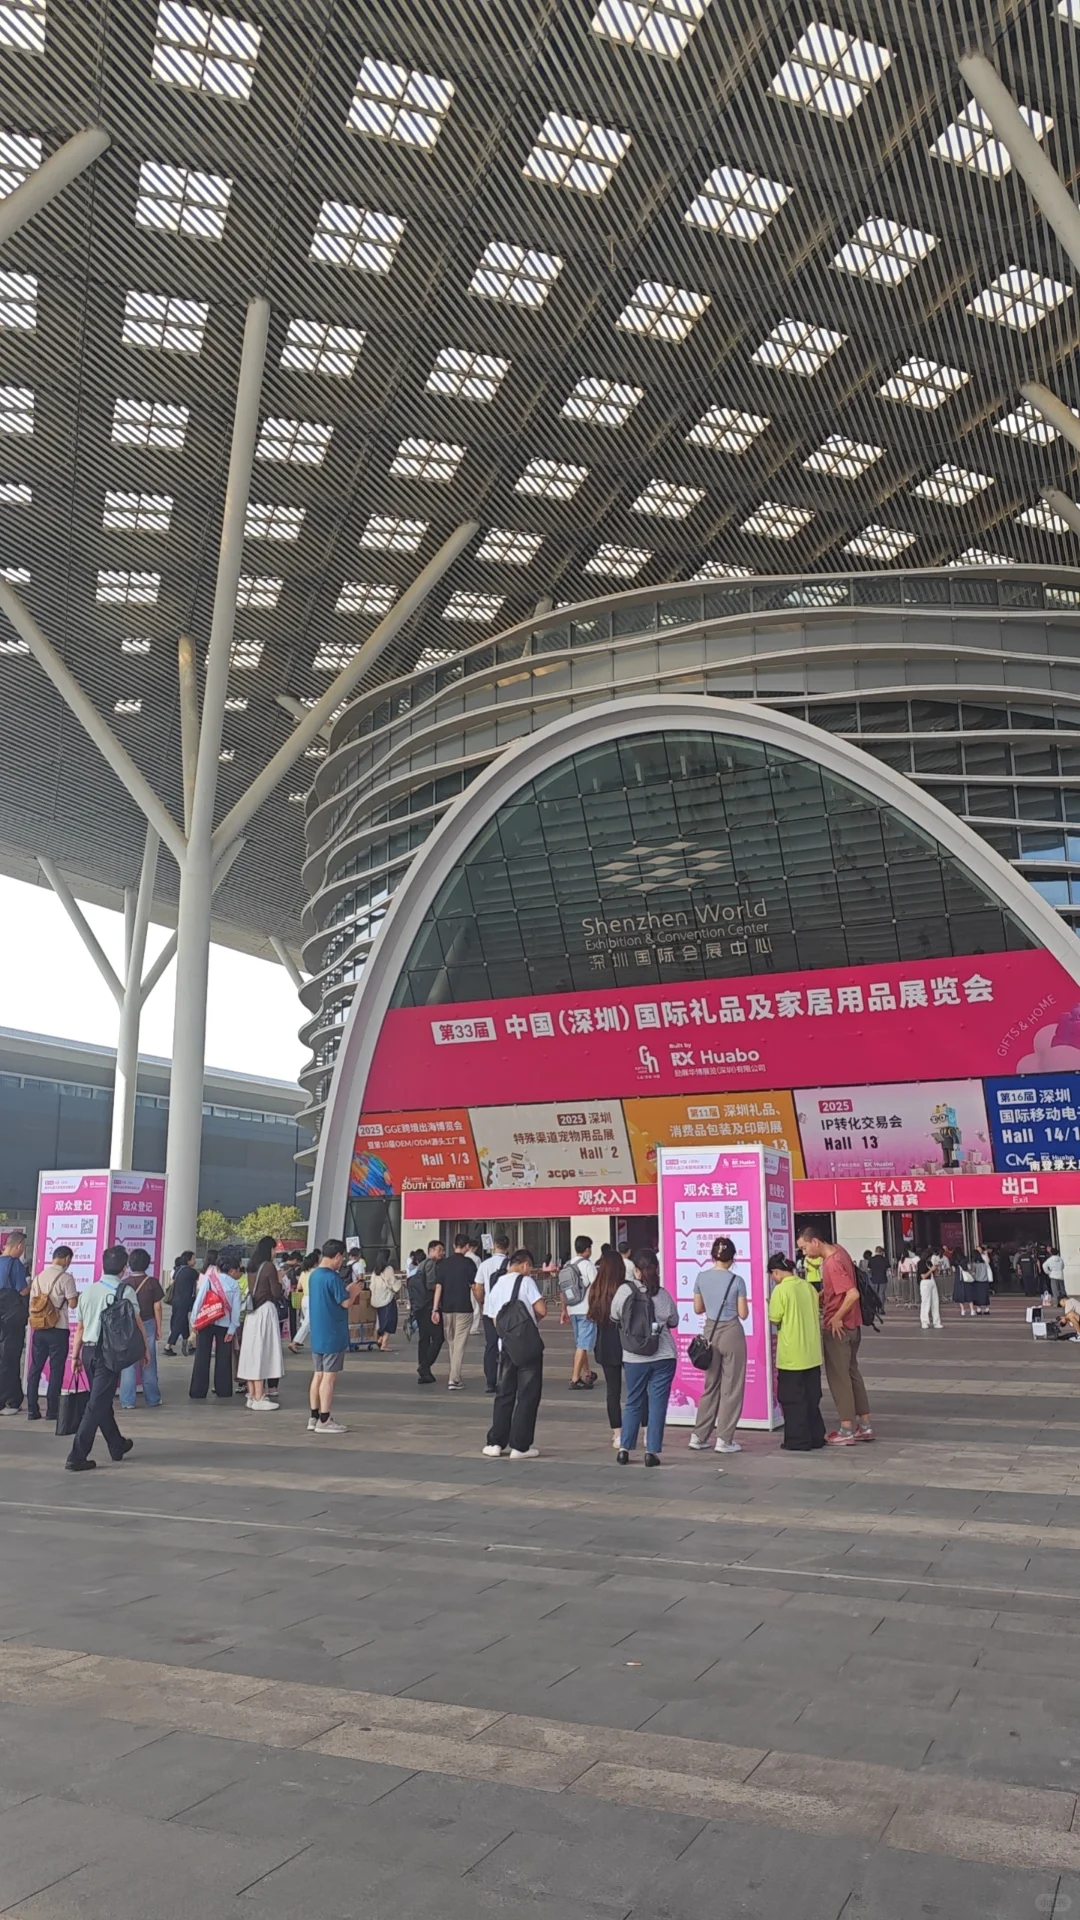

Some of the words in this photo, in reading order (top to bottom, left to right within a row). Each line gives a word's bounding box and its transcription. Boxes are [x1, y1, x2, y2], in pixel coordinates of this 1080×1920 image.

[582, 911, 689, 936] Shenzhen
[694, 898, 768, 924] World
[585, 934, 642, 951] Exhibition
[645, 933, 655, 944] &
[657, 926, 725, 943] Convention
[727, 921, 770, 937] Center
[588, 937, 773, 971] 深圳国际会展中心
[438, 1021, 490, 1041] 第33届
[996, 1027, 1021, 1057] GIFTS
[1018, 1020, 1030, 1032] &
[1027, 993, 1058, 1025] HOME
[671, 1051, 696, 1066] RX
[699, 1048, 760, 1065] Huabo
[1000, 1091, 1035, 1103] 第16届
[1038, 1088, 1071, 1103] 深圳
[690, 1107, 718, 1118] 第11届
[821, 1101, 850, 1112] 2025
[560, 1114, 585, 1125] 2025
[588, 1111, 612, 1124] 深圳
[999, 1106, 1080, 1124] 国际移动电
[669, 1121, 784, 1138] 消费品包装及印刷展
[821, 1114, 903, 1131] IP转化交易会
[360, 1126, 381, 1135] 2025
[513, 1128, 615, 1145] 特殊渠道宠物用品展
[1002, 1128, 1034, 1144] Hall
[772, 1139, 788, 1152] 13
[824, 1136, 851, 1150] Hall
[862, 1135, 879, 1149] 13
[421, 1152, 444, 1166] Hall
[450, 1152, 470, 1165] 1/3
[580, 1146, 603, 1160] Hall
[610, 1146, 619, 1159] 2
[1005, 1152, 1035, 1166] CME
[1029, 1159, 1080, 1171] 南登录大
[401, 1182, 428, 1190] SOUTH
[431, 1181, 465, 1190] LOBBY(E)
[683, 1183, 738, 1197] 观众登记
[860, 1180, 926, 1194] 工作人员及
[1001, 1177, 1039, 1195] 出口
[578, 1189, 637, 1205] 观众入口
[865, 1193, 918, 1207] 特邀嘉宾
[1012, 1195, 1029, 1204] Exit
[54, 1199, 92, 1212] 观众登记
[122, 1200, 152, 1213] 观众登记
[591, 1205, 621, 1213] Entrance
[680, 1211, 685, 1220] 1
[680, 1240, 687, 1250] 2
[681, 1275, 689, 1286] 3
[682, 1313, 690, 1323] 4
